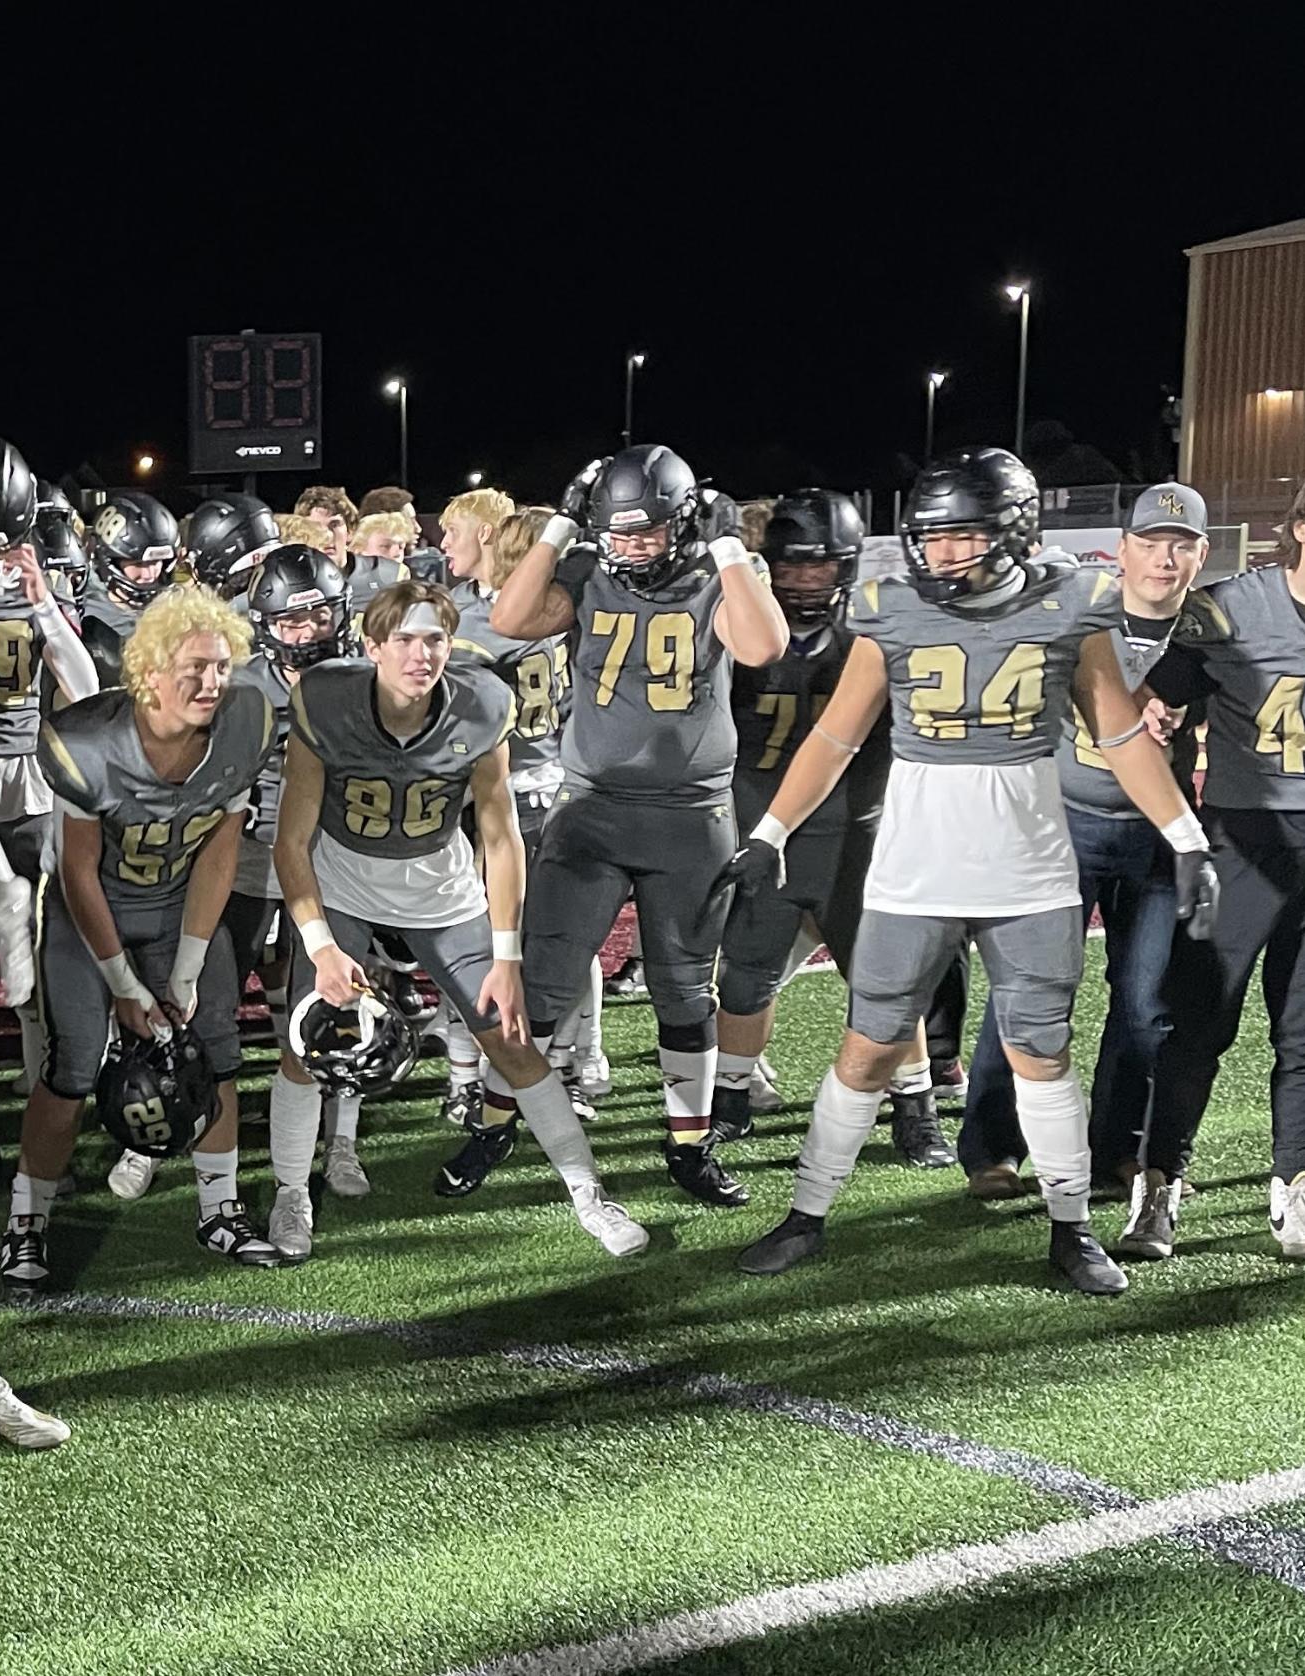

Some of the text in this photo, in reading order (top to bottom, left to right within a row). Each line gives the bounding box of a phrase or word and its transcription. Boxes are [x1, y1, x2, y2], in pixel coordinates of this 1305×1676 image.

[591, 610, 697, 713] 79
[906, 642, 1048, 741] 24
[755, 692, 830, 770] 7
[343, 776, 451, 839] 86
